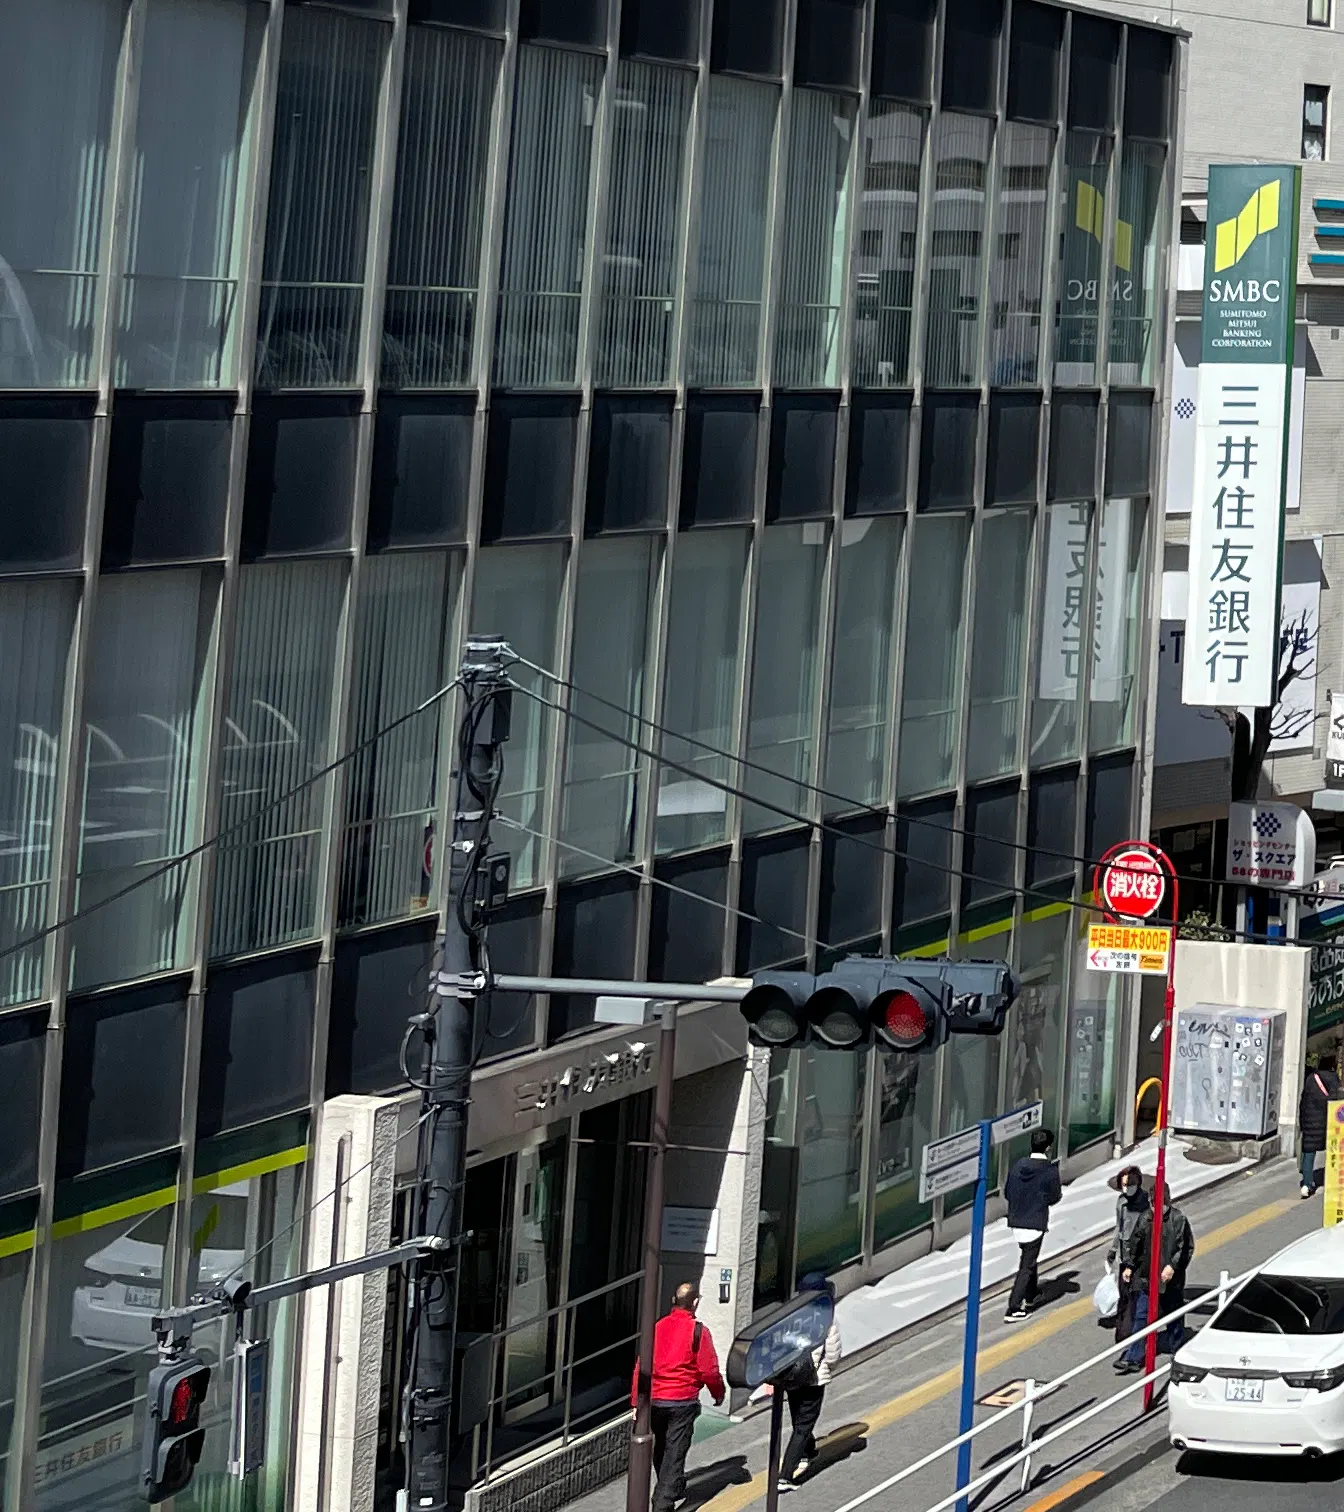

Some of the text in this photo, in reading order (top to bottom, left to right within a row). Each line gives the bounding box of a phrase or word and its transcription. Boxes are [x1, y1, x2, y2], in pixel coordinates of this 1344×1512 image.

[1209, 279, 1280, 303] SMBC
[1220, 309, 1267, 318] SUMITOMO
[1228, 320, 1257, 328] MITSUI
[1223, 329, 1262, 337] BANKING
[1211, 339, 1272, 347] CORPORATION
[1205, 384, 1261, 684] 三井住友銀行
[1232, 849, 1296, 865] ザ・スクエア
[1110, 871, 1159, 900] 消火栓
[1091, 928, 1167, 952] 平日当日最大900円
